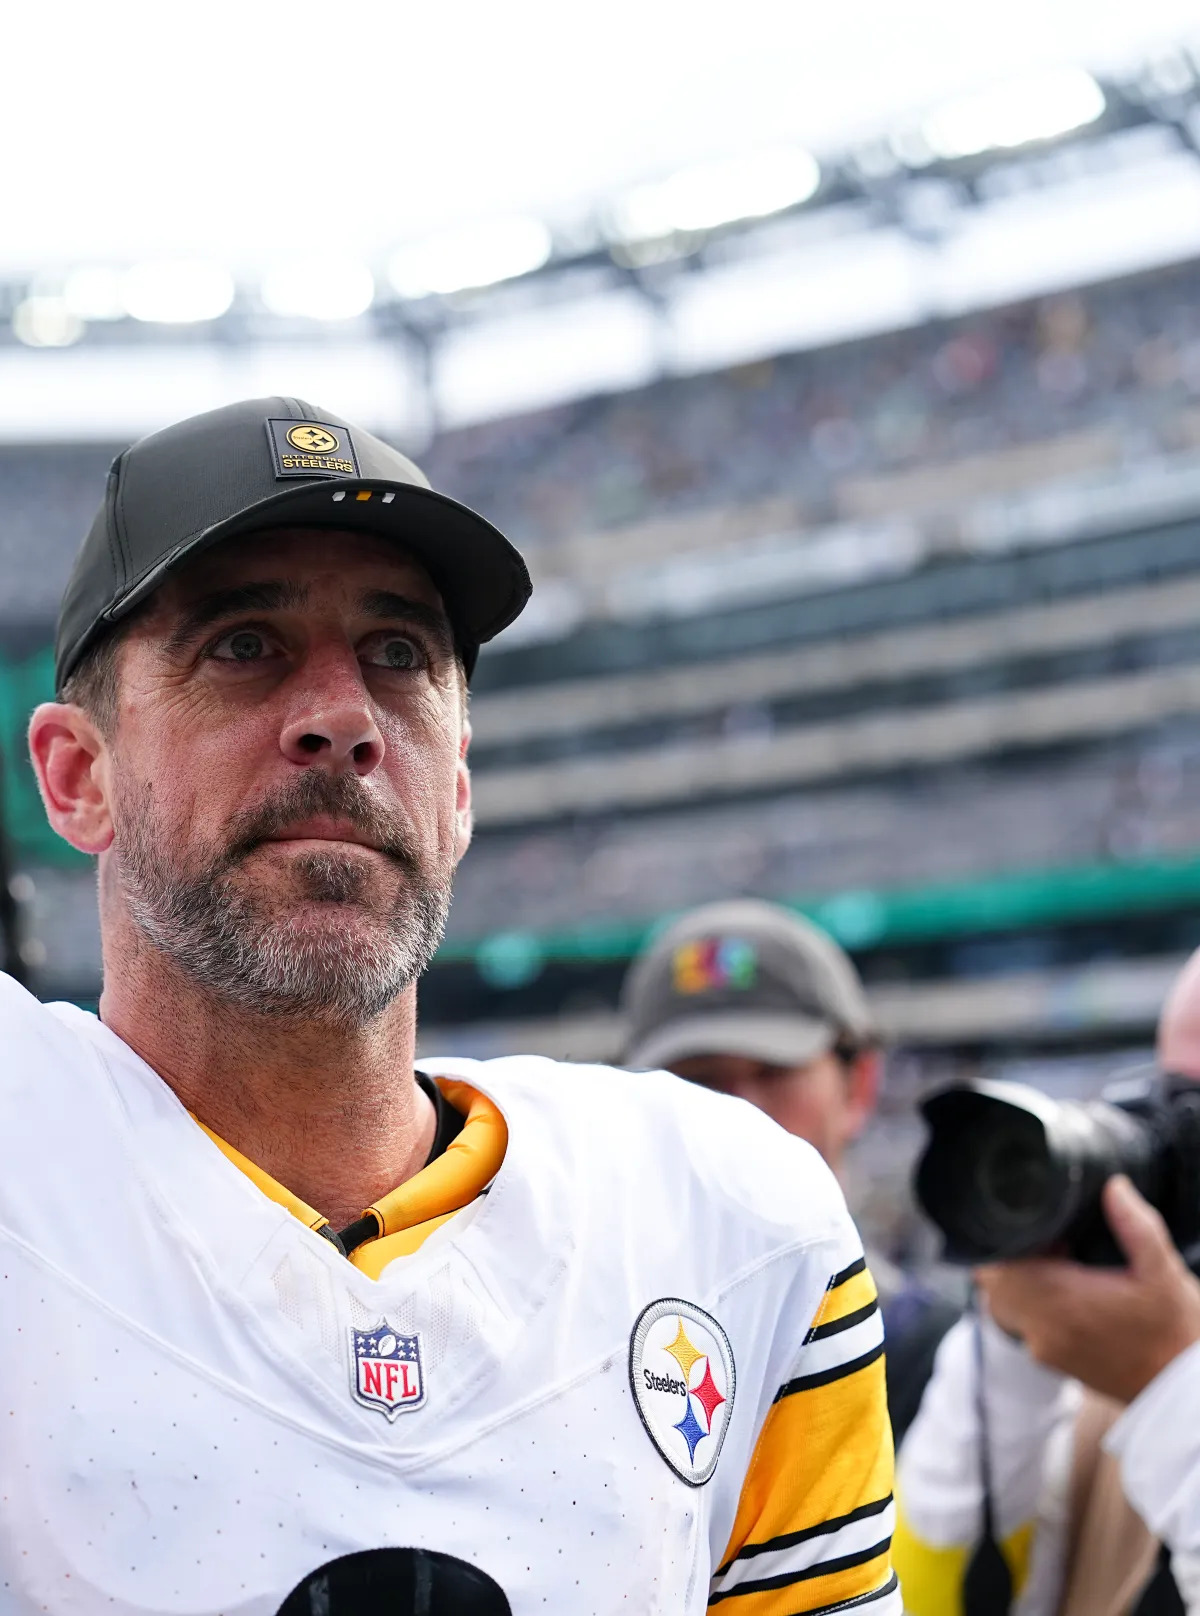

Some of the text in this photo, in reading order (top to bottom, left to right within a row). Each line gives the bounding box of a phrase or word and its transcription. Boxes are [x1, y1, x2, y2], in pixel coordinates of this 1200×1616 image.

[283, 459, 353, 473] STEELERS
[362, 1361, 417, 1402] NFL
[643, 1368, 686, 1397] Steelers
